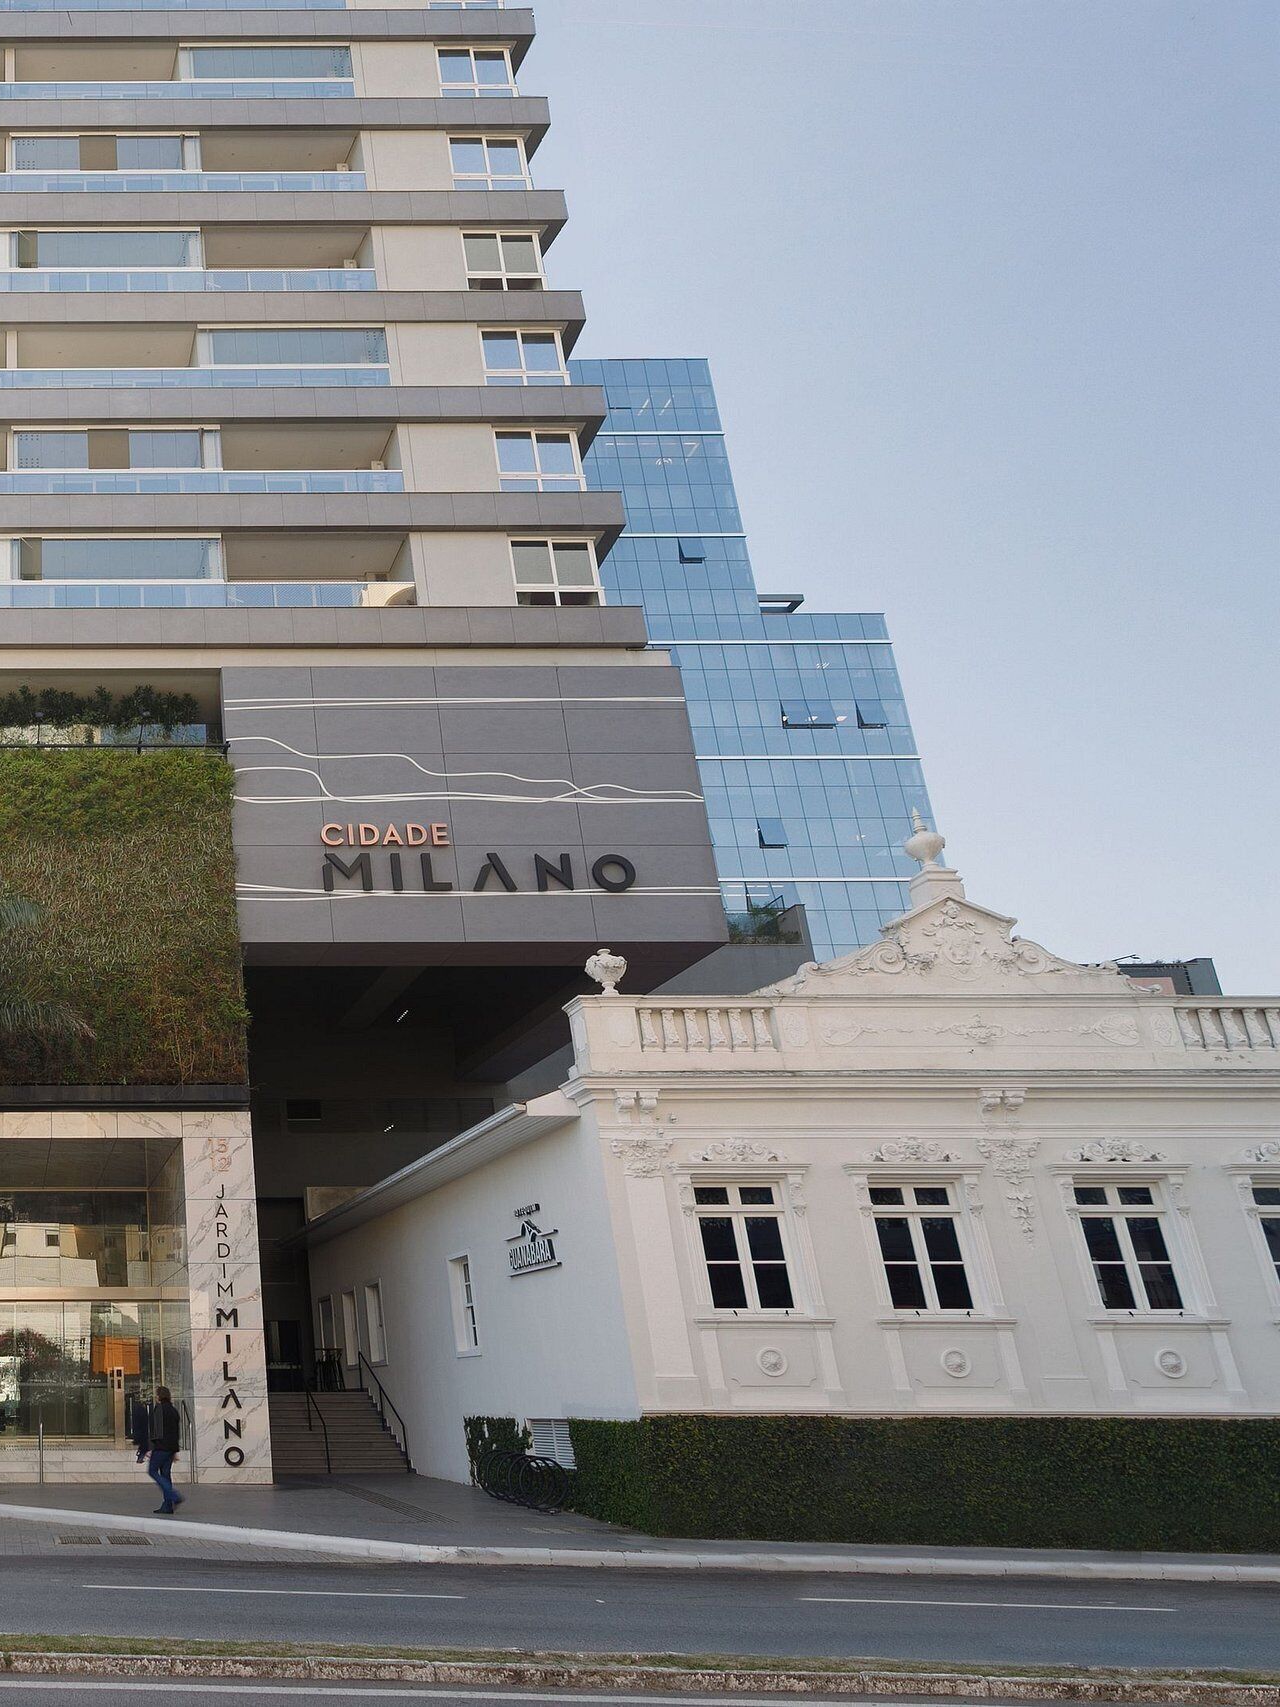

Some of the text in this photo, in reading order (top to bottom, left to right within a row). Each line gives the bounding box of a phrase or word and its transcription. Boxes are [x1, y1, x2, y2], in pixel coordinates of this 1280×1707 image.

[320, 823, 450, 846] CIDADE
[322, 852, 637, 893] MILANO
[215, 1183, 234, 1298] JARDIM
[509, 1238, 557, 1270] GUANABARA
[216, 1307, 245, 1468] MILANO
